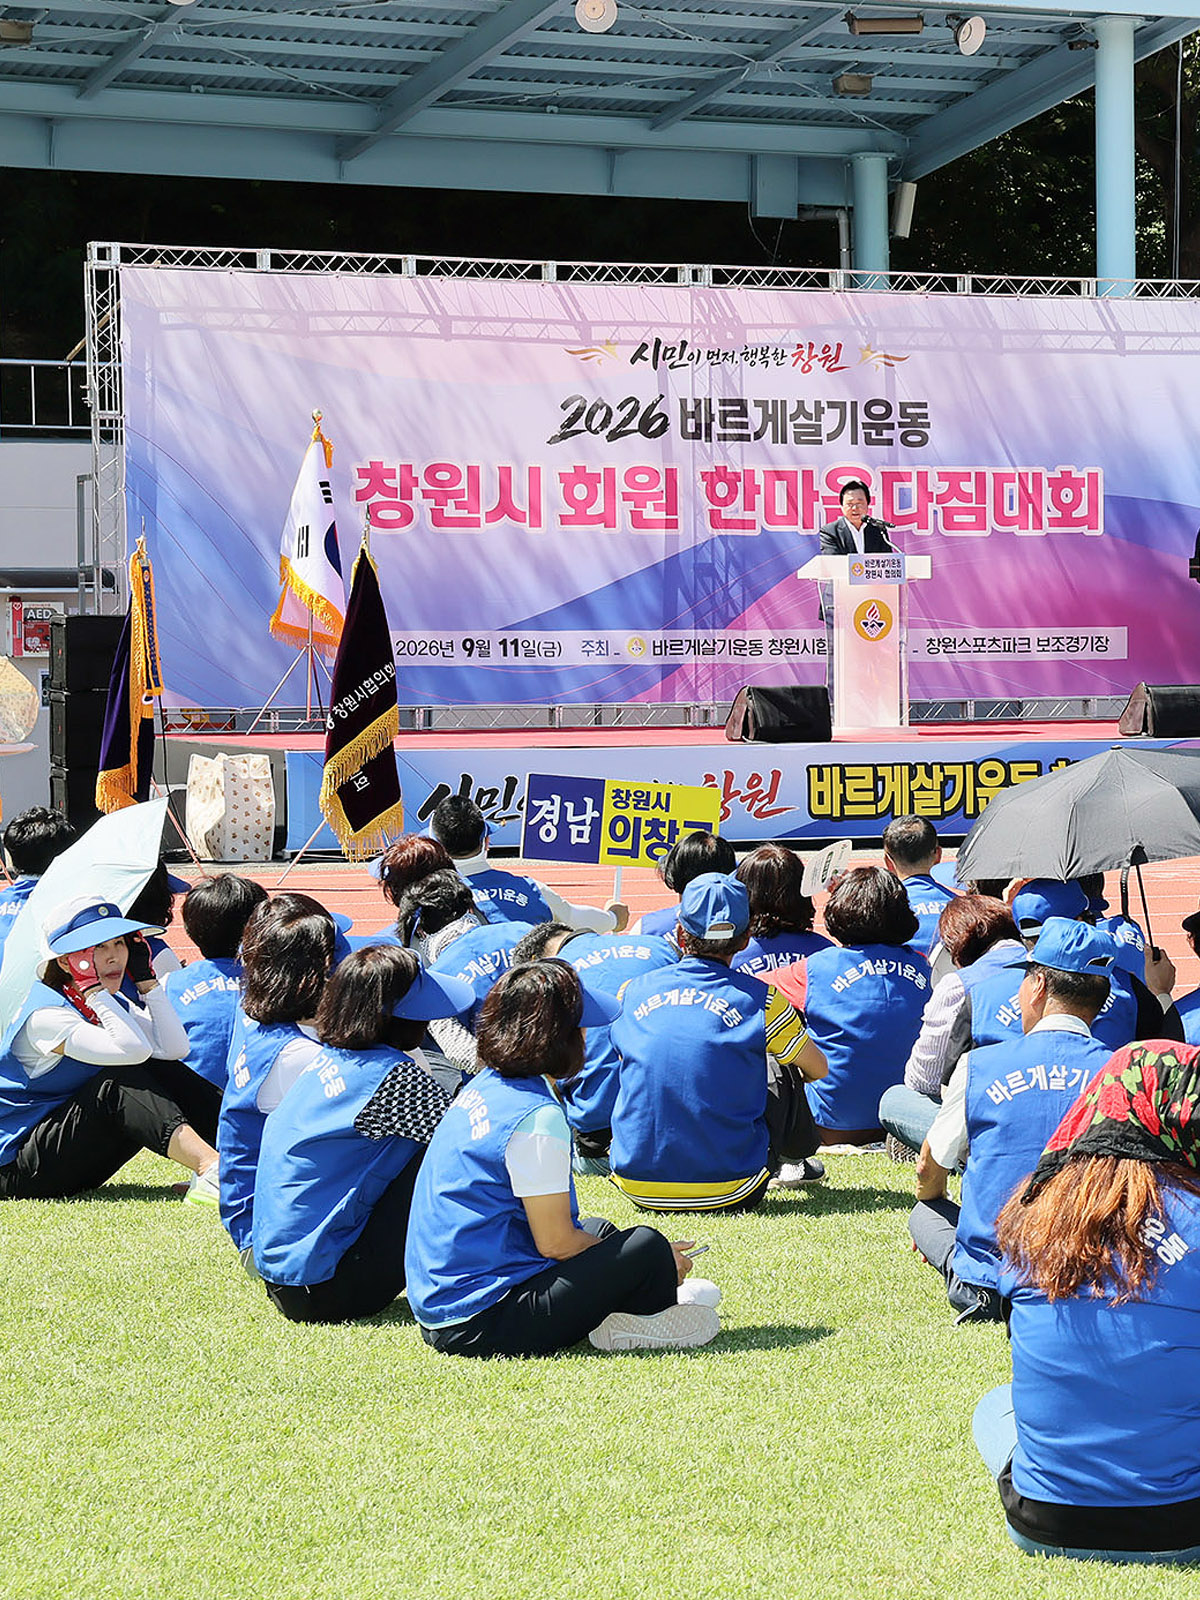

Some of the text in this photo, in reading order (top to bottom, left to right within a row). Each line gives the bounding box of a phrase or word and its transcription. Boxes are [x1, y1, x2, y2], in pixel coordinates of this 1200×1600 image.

[630, 337, 700, 370] 시민이
[743, 344, 787, 369] 행복한
[791, 342, 853, 374] 창원
[546, 394, 932, 448] 2026 바르게살기운동
[354, 460, 543, 531] 창원시
[557, 465, 679, 530] 회원
[27, 609, 52, 619] AED
[396, 639, 454, 658] 2026년
[461, 637, 491, 658] 9월
[498, 637, 562, 658] 11일(금)
[581, 639, 609, 657] 주최
[652, 637, 763, 657] 바르게살기운동
[926, 636, 1031, 655] 창원스포츠파크
[1036, 635, 1110, 653] 보조경기장
[611, 788, 671, 812] 창원시
[529, 795, 600, 845] 경남
[830, 958, 928, 994] 바르게살기운동
[632, 987, 744, 1029] 바르게살기운동
